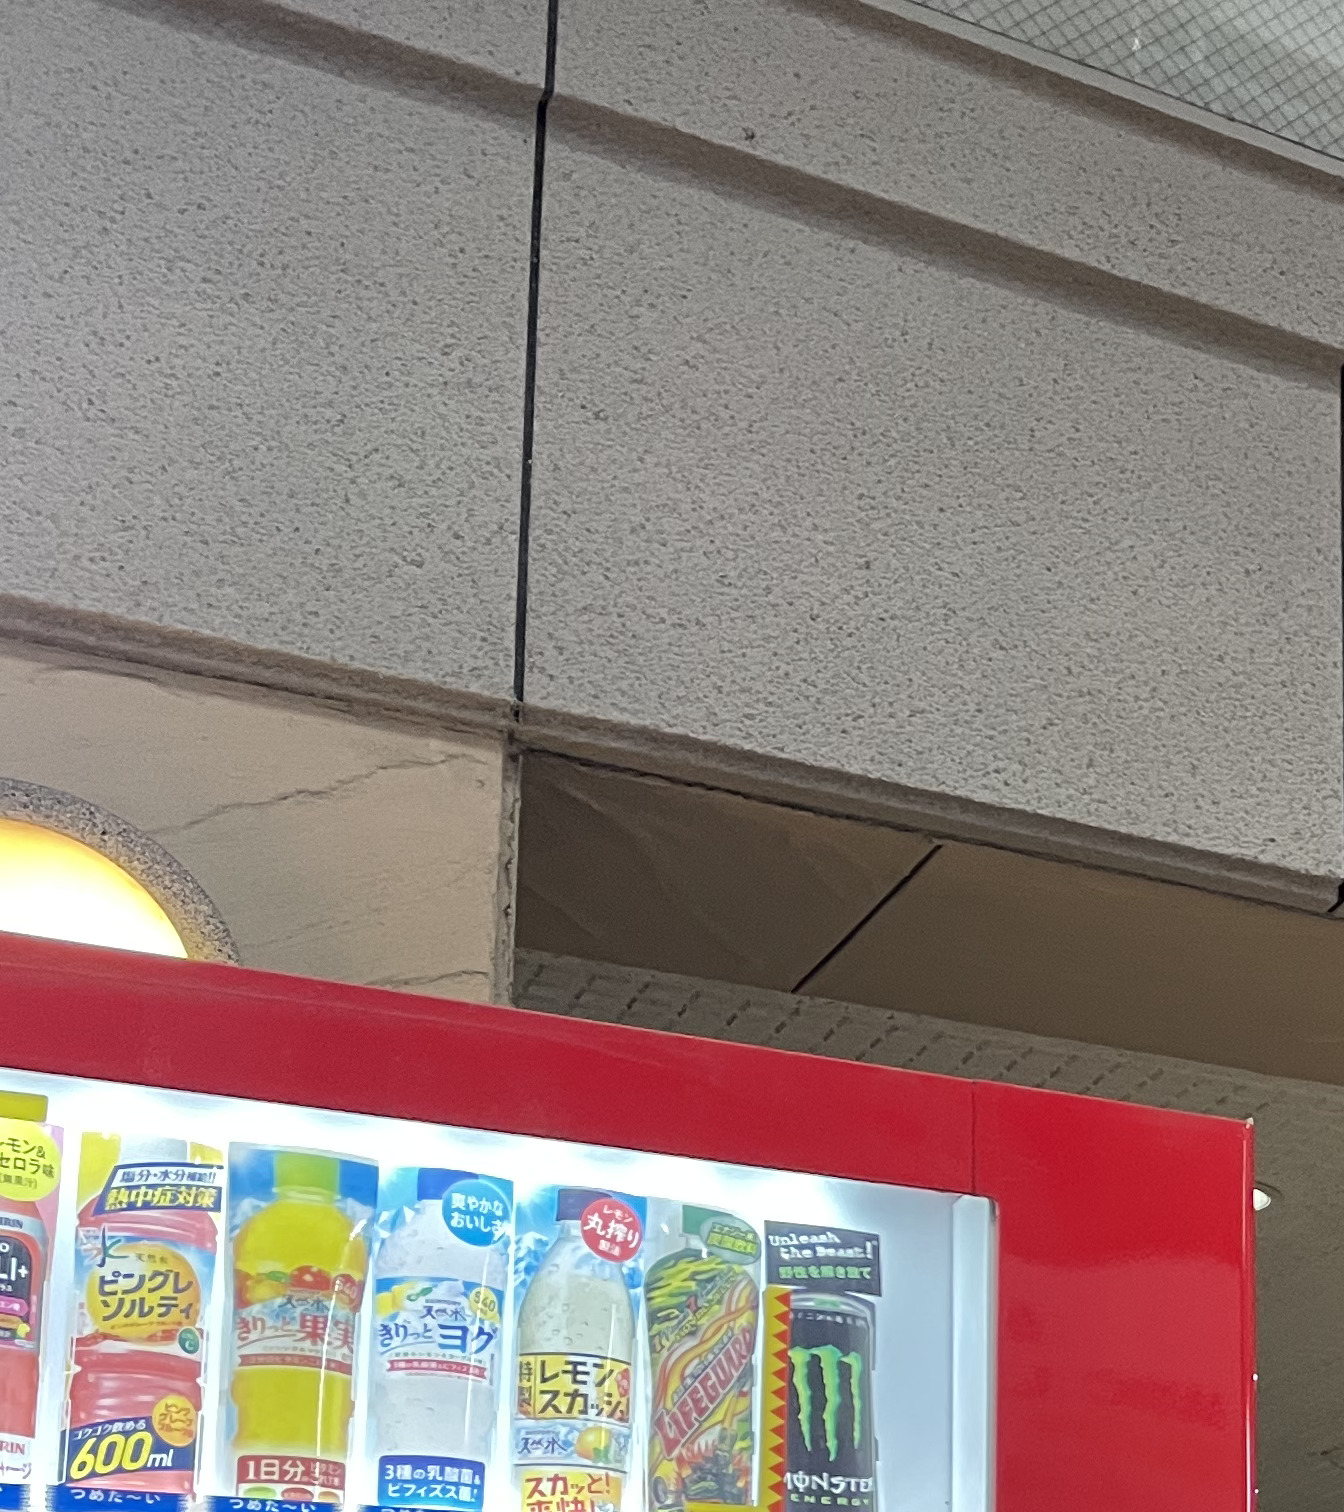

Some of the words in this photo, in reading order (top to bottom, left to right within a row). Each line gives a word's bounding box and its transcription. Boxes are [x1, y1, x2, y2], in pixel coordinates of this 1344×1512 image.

[0, 1137, 46, 1159] モン&
[104, 1186, 219, 1212] 熱中症対策
[768, 1232, 842, 1247] Unleash
[98, 1269, 194, 1297] ピングレ
[99, 1296, 194, 1321] ソルティ
[539, 1359, 615, 1388] レモン
[70, 1431, 173, 1481] 600ml
